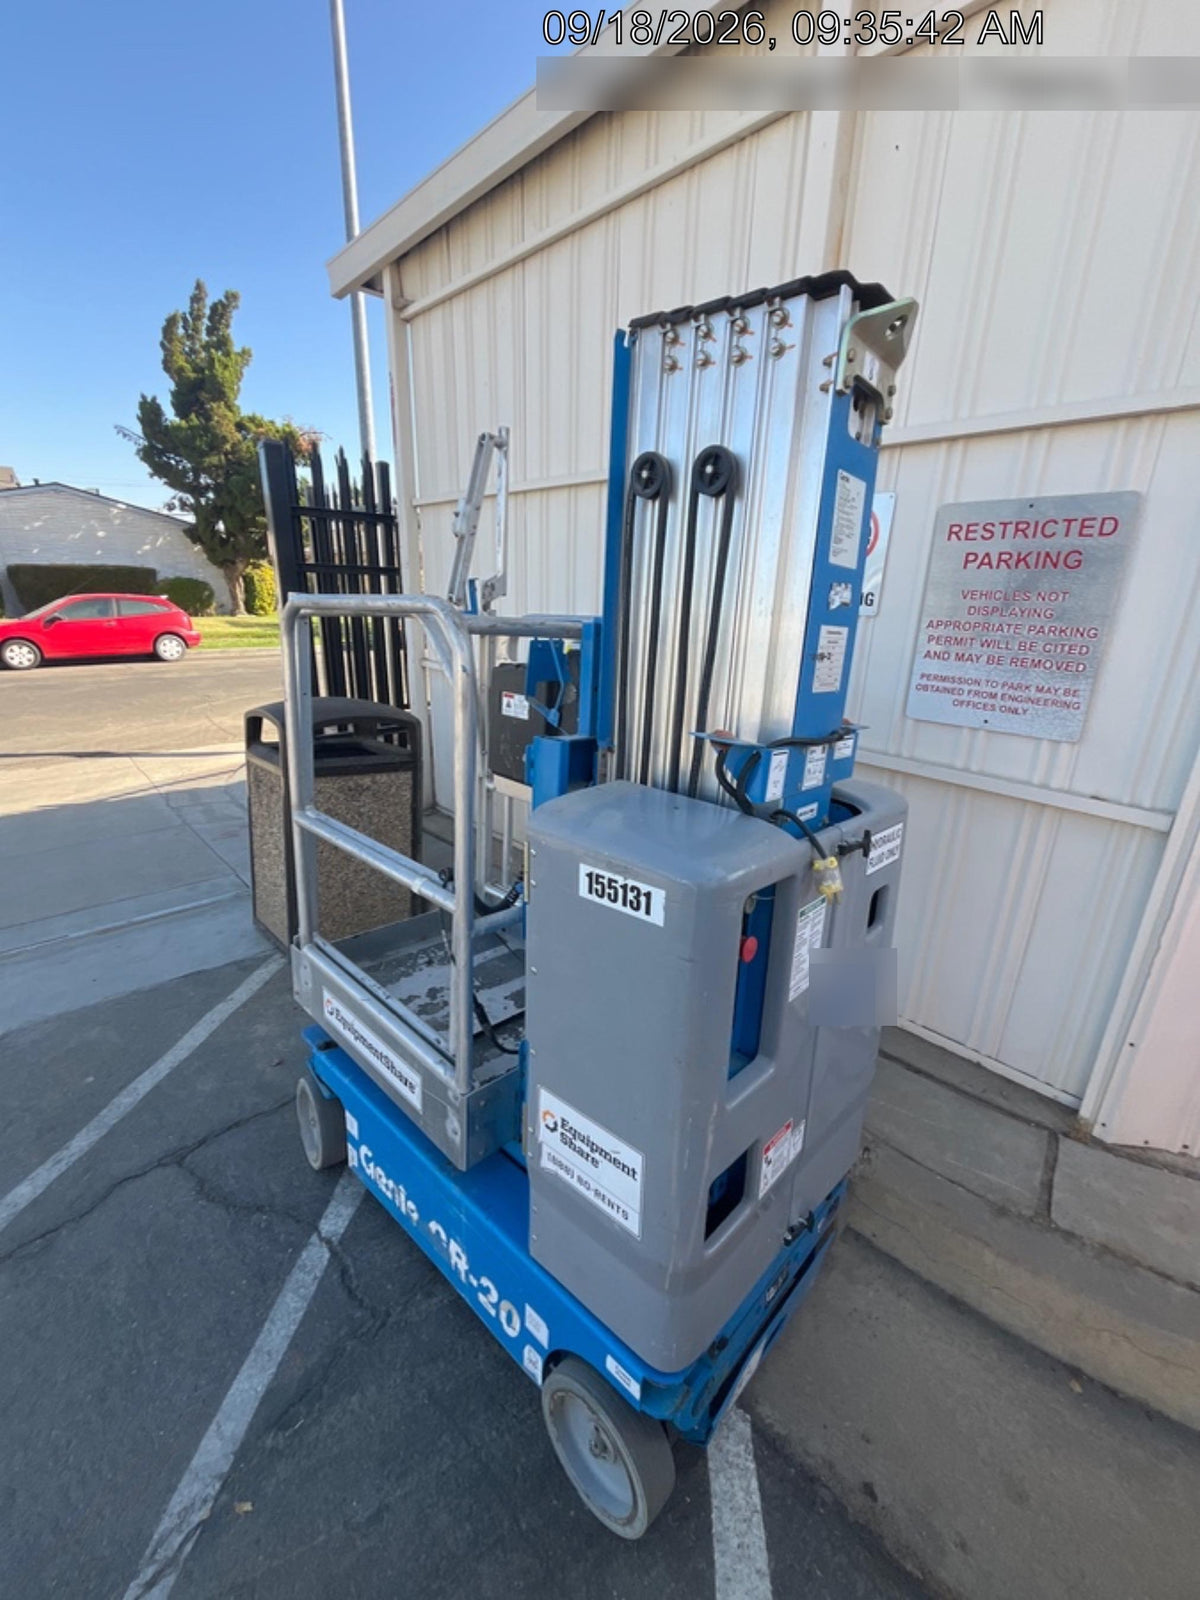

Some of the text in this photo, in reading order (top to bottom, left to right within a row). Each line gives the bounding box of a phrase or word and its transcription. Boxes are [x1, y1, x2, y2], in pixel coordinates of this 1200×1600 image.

[947, 516, 1120, 541] RESTRICTED
[962, 550, 1083, 570] PARKING
[961, 589, 1070, 602] VEHICLES NOT
[967, 606, 1054, 619] DISPLAYING
[926, 620, 1099, 639] APPROPRIATE PARKING
[927, 635, 1090, 656] PERMIT WILL BE CITED
[923, 650, 1087, 673] AND MAY BE REMOVED
[915, 683, 1081, 710] OBTAINED FROM ENGINEERING
[919, 673, 1081, 698] PERMISSION TO PARK MAY BE
[952, 699, 1030, 715] OFFICES ONLY
[585, 871, 652, 916] 155131
[335, 1007, 416, 1094] EquipmentShare
[560, 1116, 638, 1181] Equipment
[560, 1132, 600, 1169] Share
[358, 1144, 420, 1227] Genie
